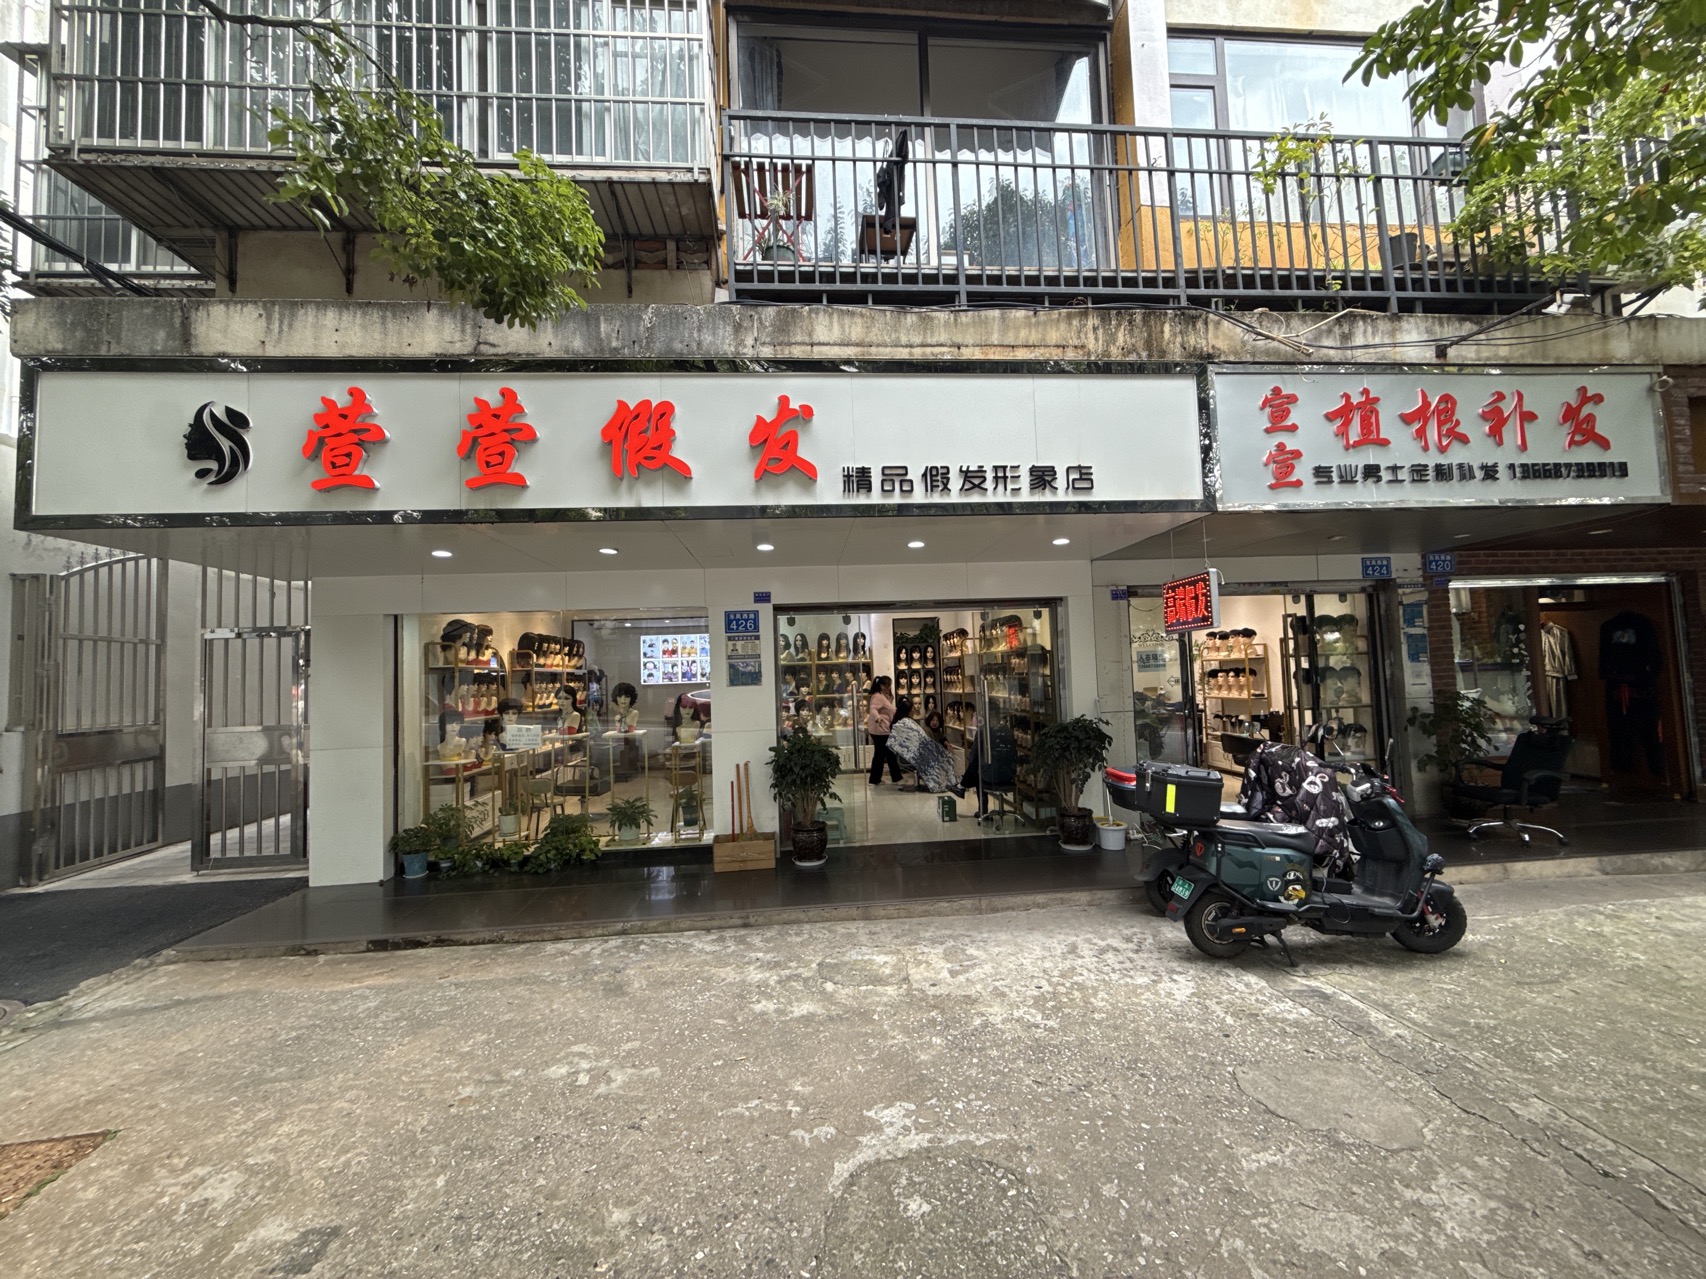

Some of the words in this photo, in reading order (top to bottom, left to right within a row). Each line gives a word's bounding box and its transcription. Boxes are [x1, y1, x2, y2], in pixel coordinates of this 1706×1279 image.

[1322, 385, 1612, 454] 植根补发
[302, 386, 819, 492] 萱萱假发
[1259, 386, 1304, 490] 宣宣
[841, 464, 1095, 493] 精品假发形象店
[1312, 462, 1501, 485] 专业男士定制补发
[1366, 566, 1388, 576] 424
[1430, 561, 1451, 571] 420
[730, 620, 754, 631] 426
